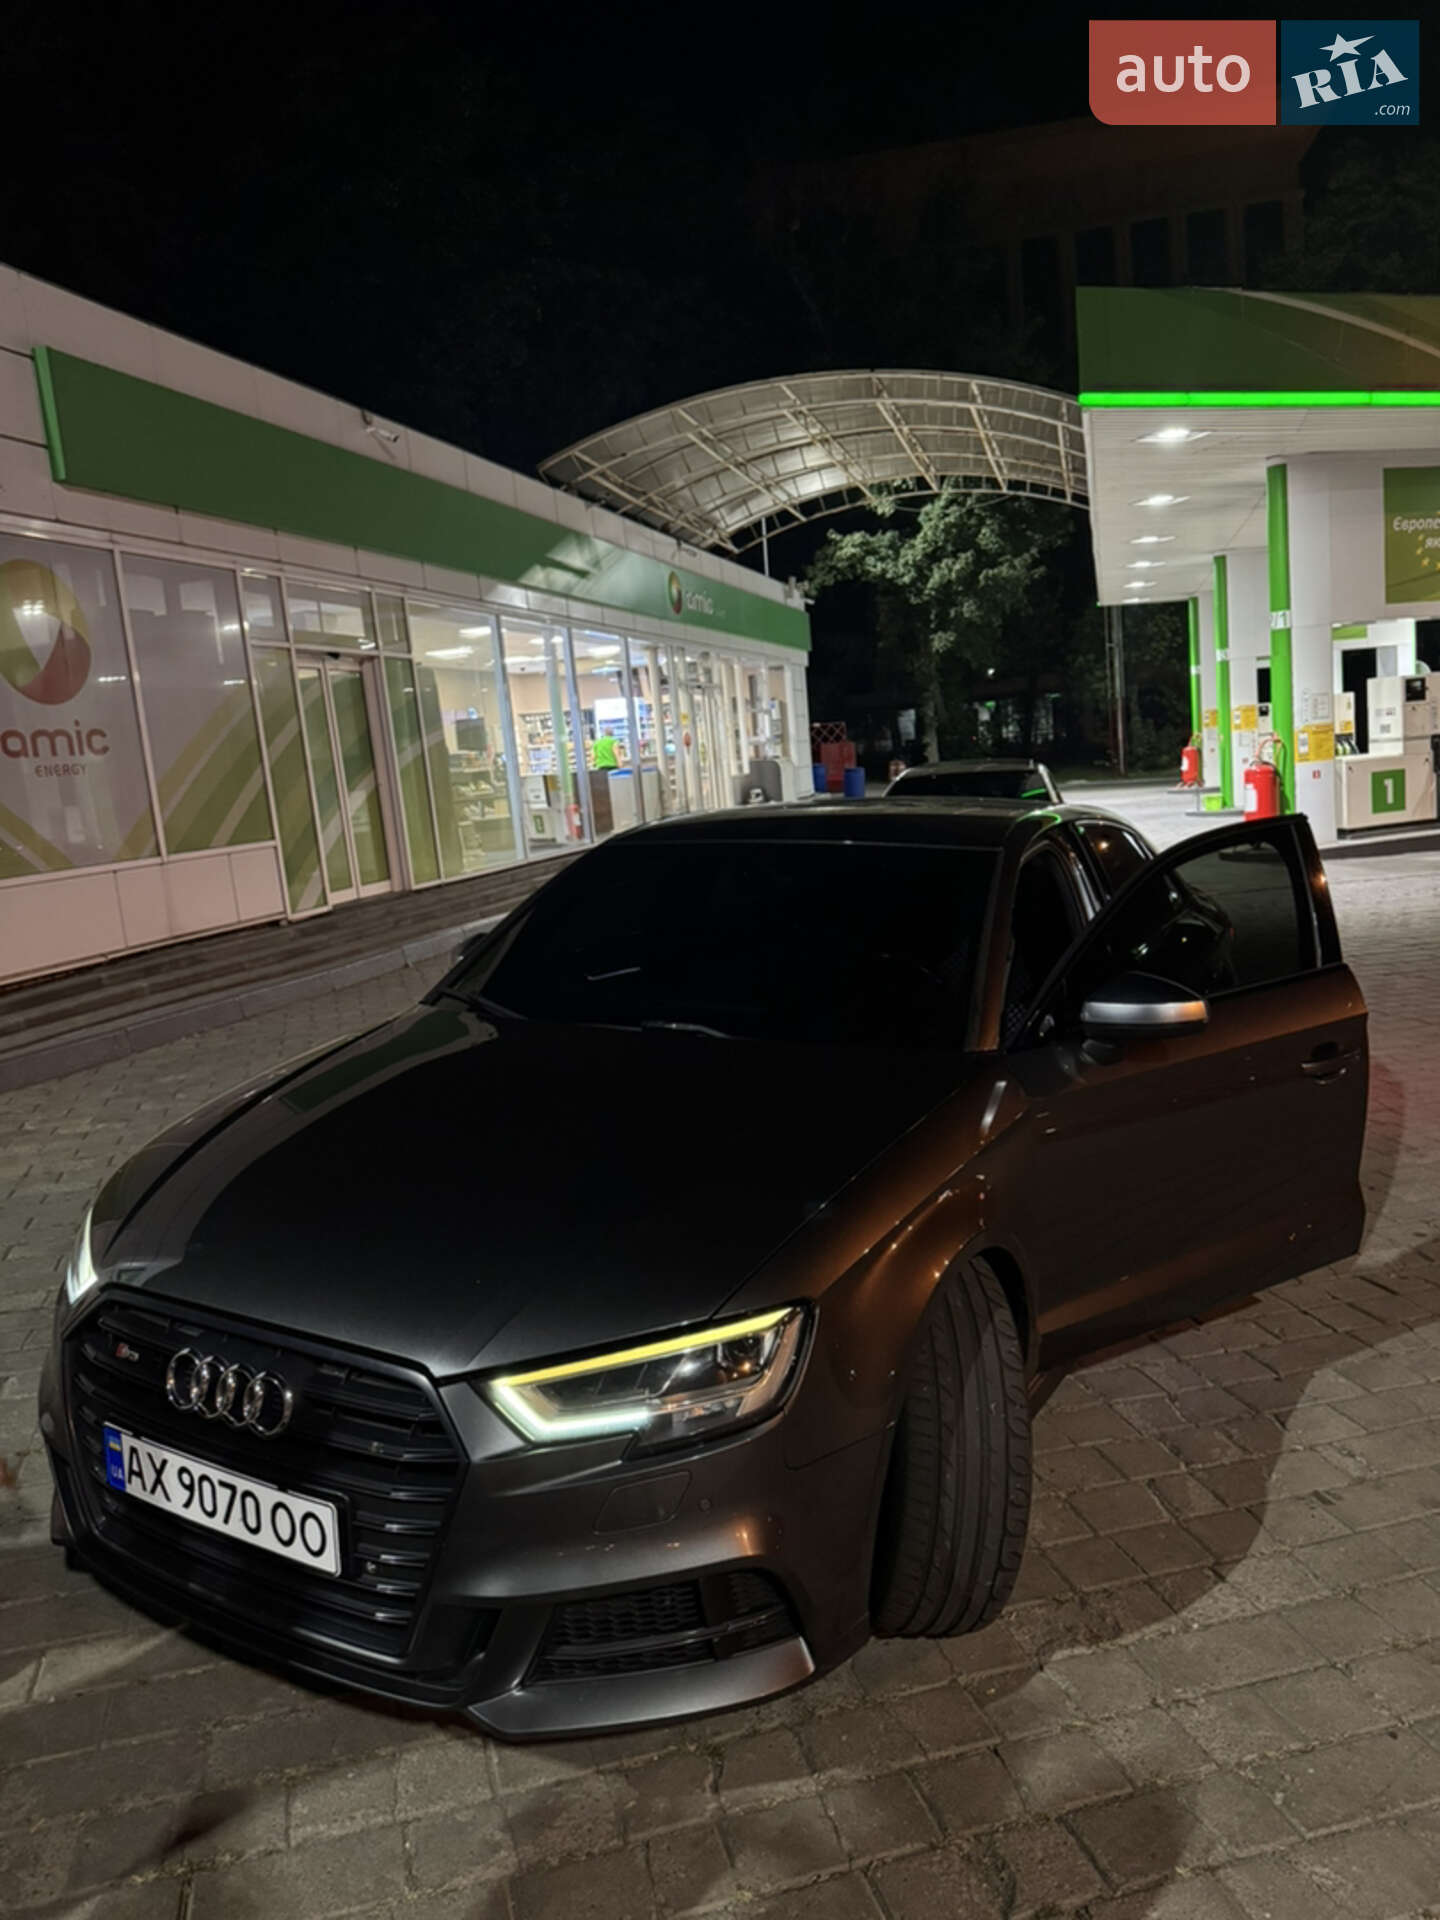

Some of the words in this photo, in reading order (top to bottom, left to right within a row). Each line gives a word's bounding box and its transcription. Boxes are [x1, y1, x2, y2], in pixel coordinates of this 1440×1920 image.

[0, 719, 110, 758] amic
[34, 763, 87, 777] ENERGY
[1384, 778, 1394, 805] 1
[127, 1445, 171, 1503] AX
[177, 1466, 262, 1535] 9070
[271, 1501, 326, 1558] OO
